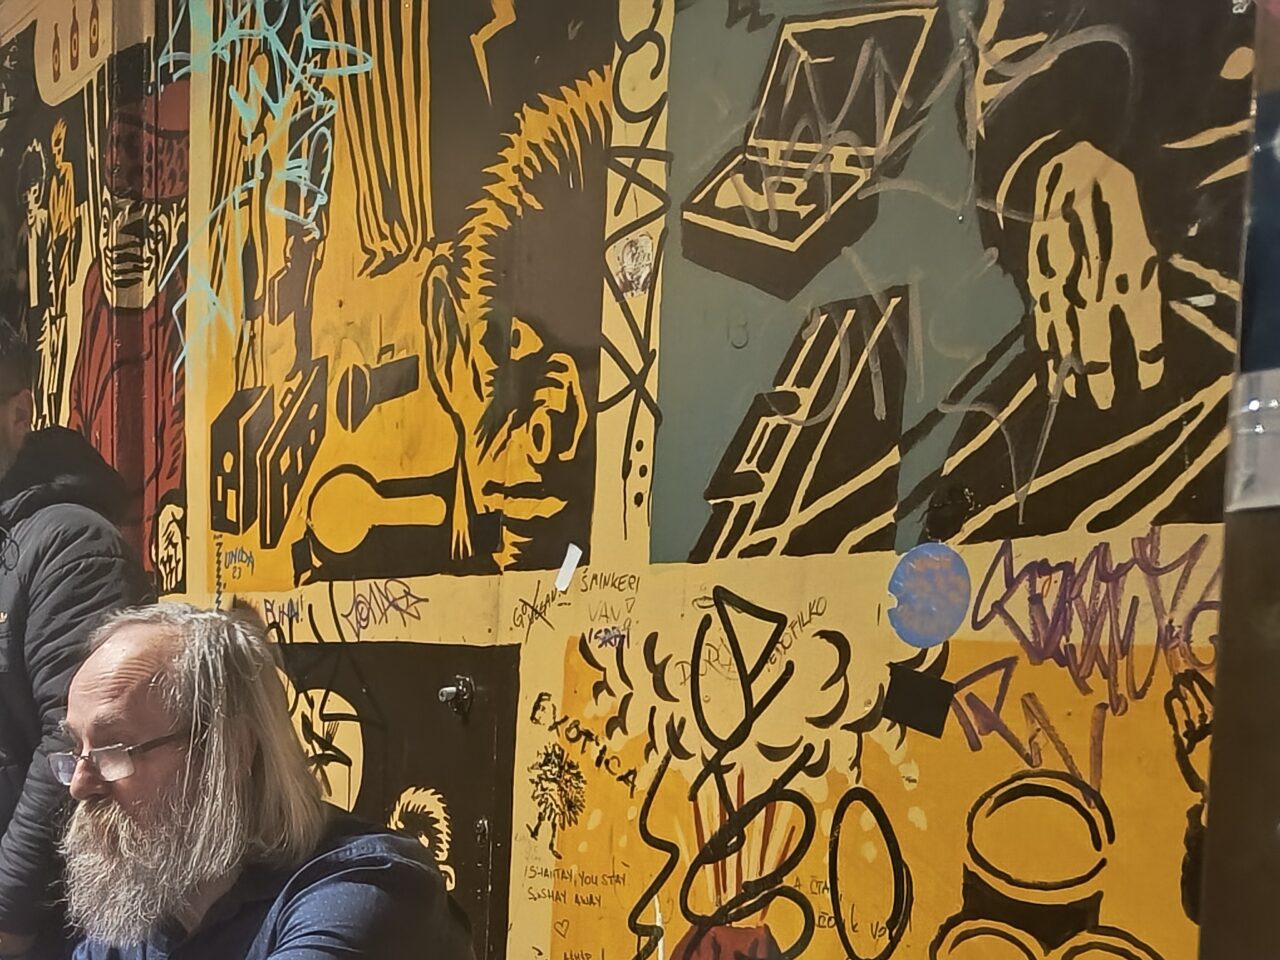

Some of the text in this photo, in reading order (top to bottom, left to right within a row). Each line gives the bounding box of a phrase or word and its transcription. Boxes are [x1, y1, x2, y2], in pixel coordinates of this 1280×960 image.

[578, 871, 598, 887] YOU
[601, 873, 626, 887] STAY
[574, 894, 602, 907] AWAY
